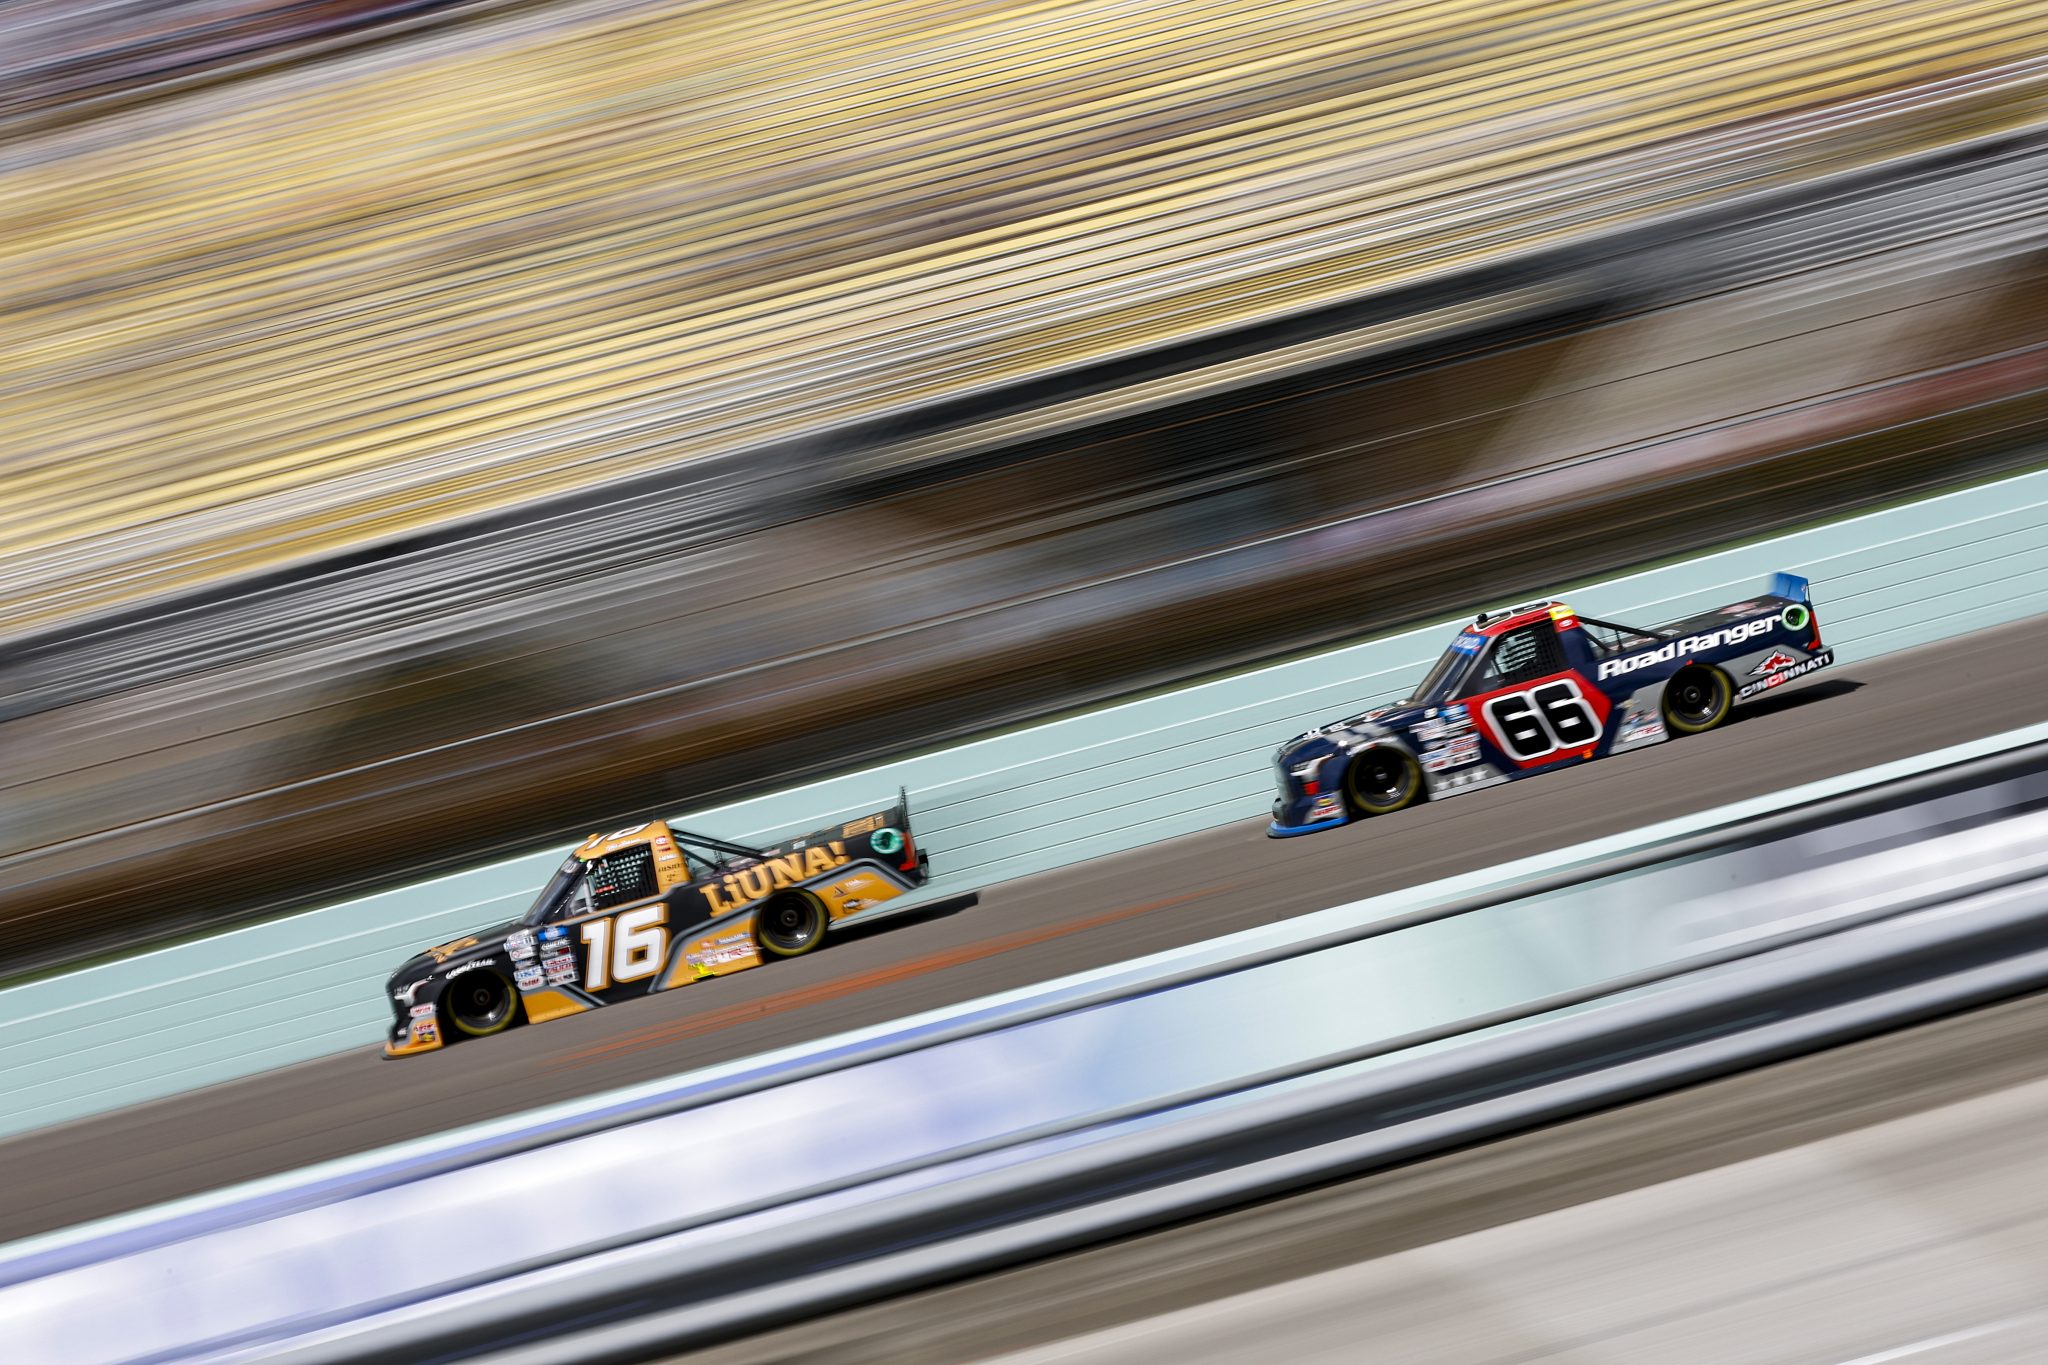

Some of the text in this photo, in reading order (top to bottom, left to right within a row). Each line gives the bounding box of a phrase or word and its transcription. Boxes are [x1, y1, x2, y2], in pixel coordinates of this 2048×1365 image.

[1597, 614, 1782, 681] Road Ranger
[1739, 654, 1830, 697] CINCINNATI
[1482, 678, 1604, 761] 66
[699, 841, 852, 918] LiUNA!
[581, 902, 672, 993] 16
